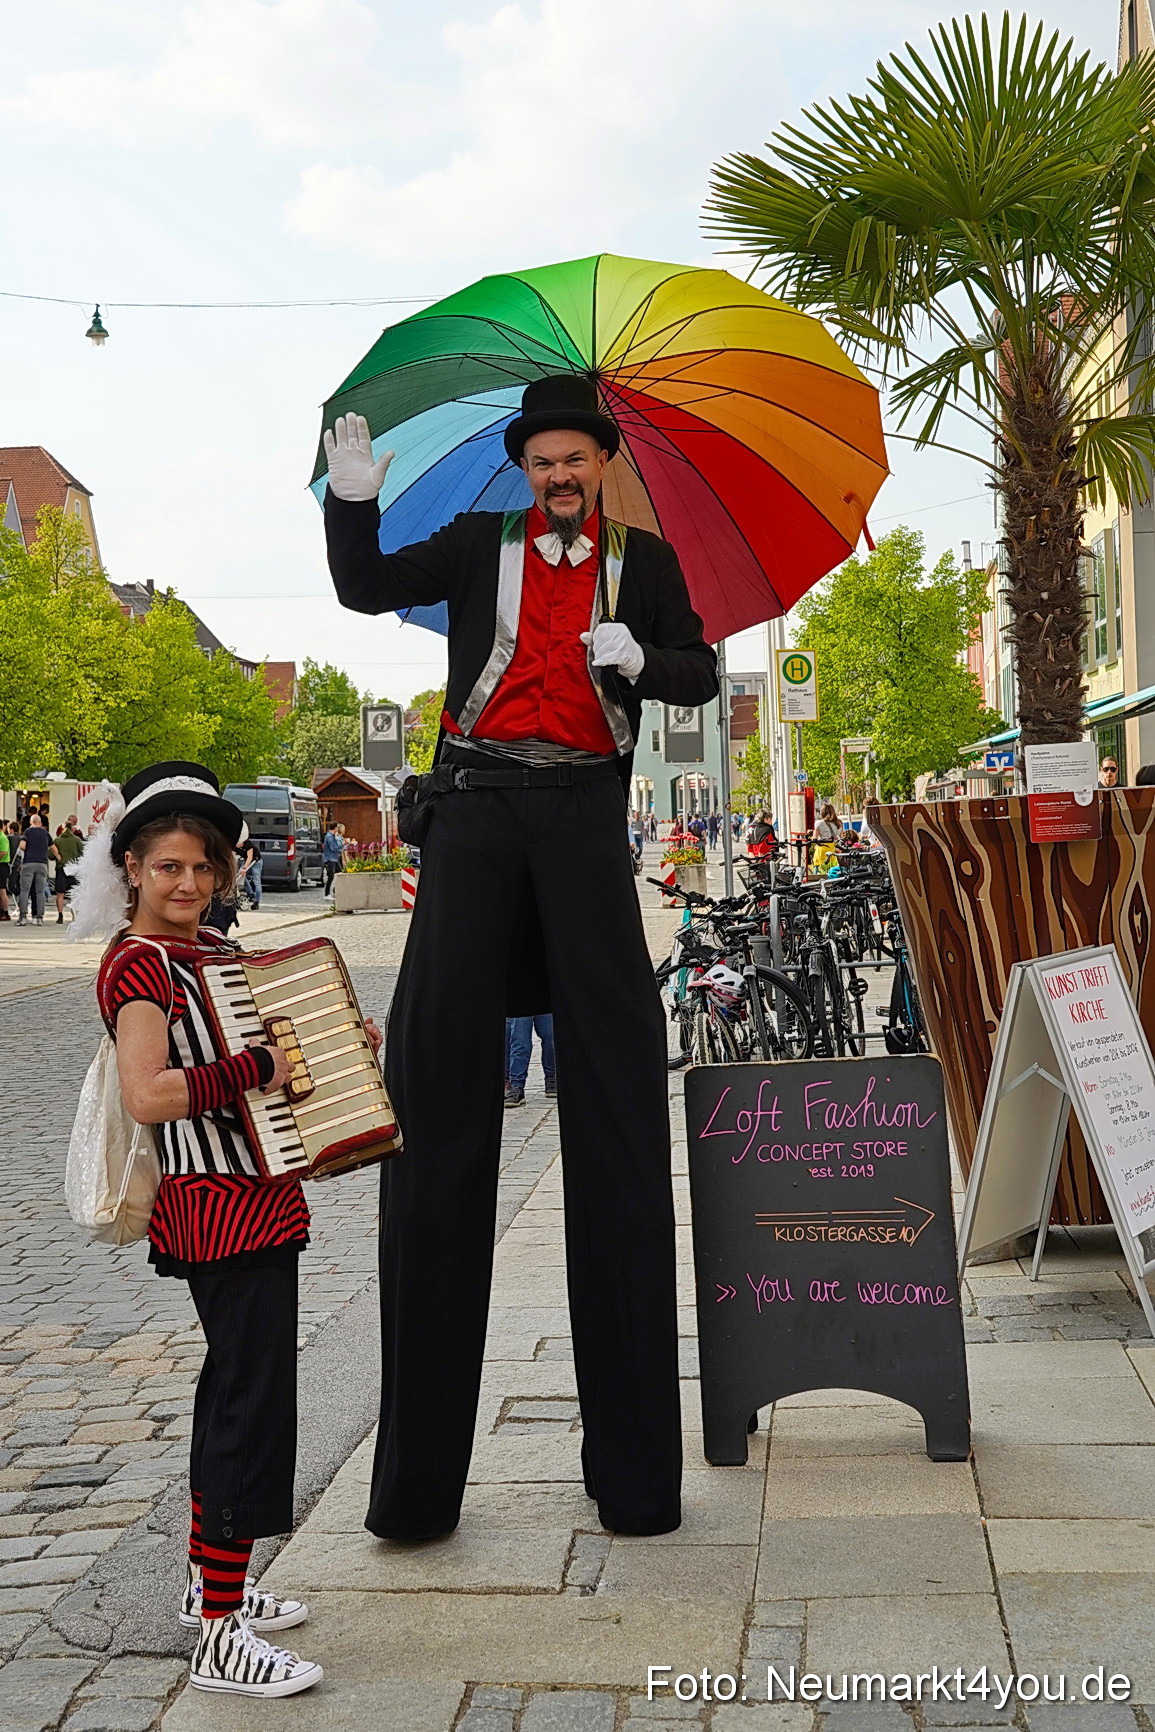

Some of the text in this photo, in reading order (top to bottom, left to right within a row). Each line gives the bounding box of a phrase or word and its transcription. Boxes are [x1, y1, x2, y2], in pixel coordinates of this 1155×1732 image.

[791, 661, 804, 678] H
[1045, 966, 1109, 1000] KUNST TRIFFT
[1069, 999, 1108, 1024] KIRCHE
[1068, 1037, 1085, 1052] Verkauf
[1095, 1031, 1125, 1049] gespendeten
[1074, 1053, 1101, 1070] Kunstwerken
[1119, 1047, 1127, 1057] bis
[699, 1076, 937, 1164] Loft Fashion
[757, 1141, 908, 1162] CONCEPT STORE
[810, 1164, 875, 1178] est 2019
[774, 1226, 896, 1243] KLOSTERGASSE
[809, 1280, 846, 1302] are
[858, 1282, 954, 1306] welcome
